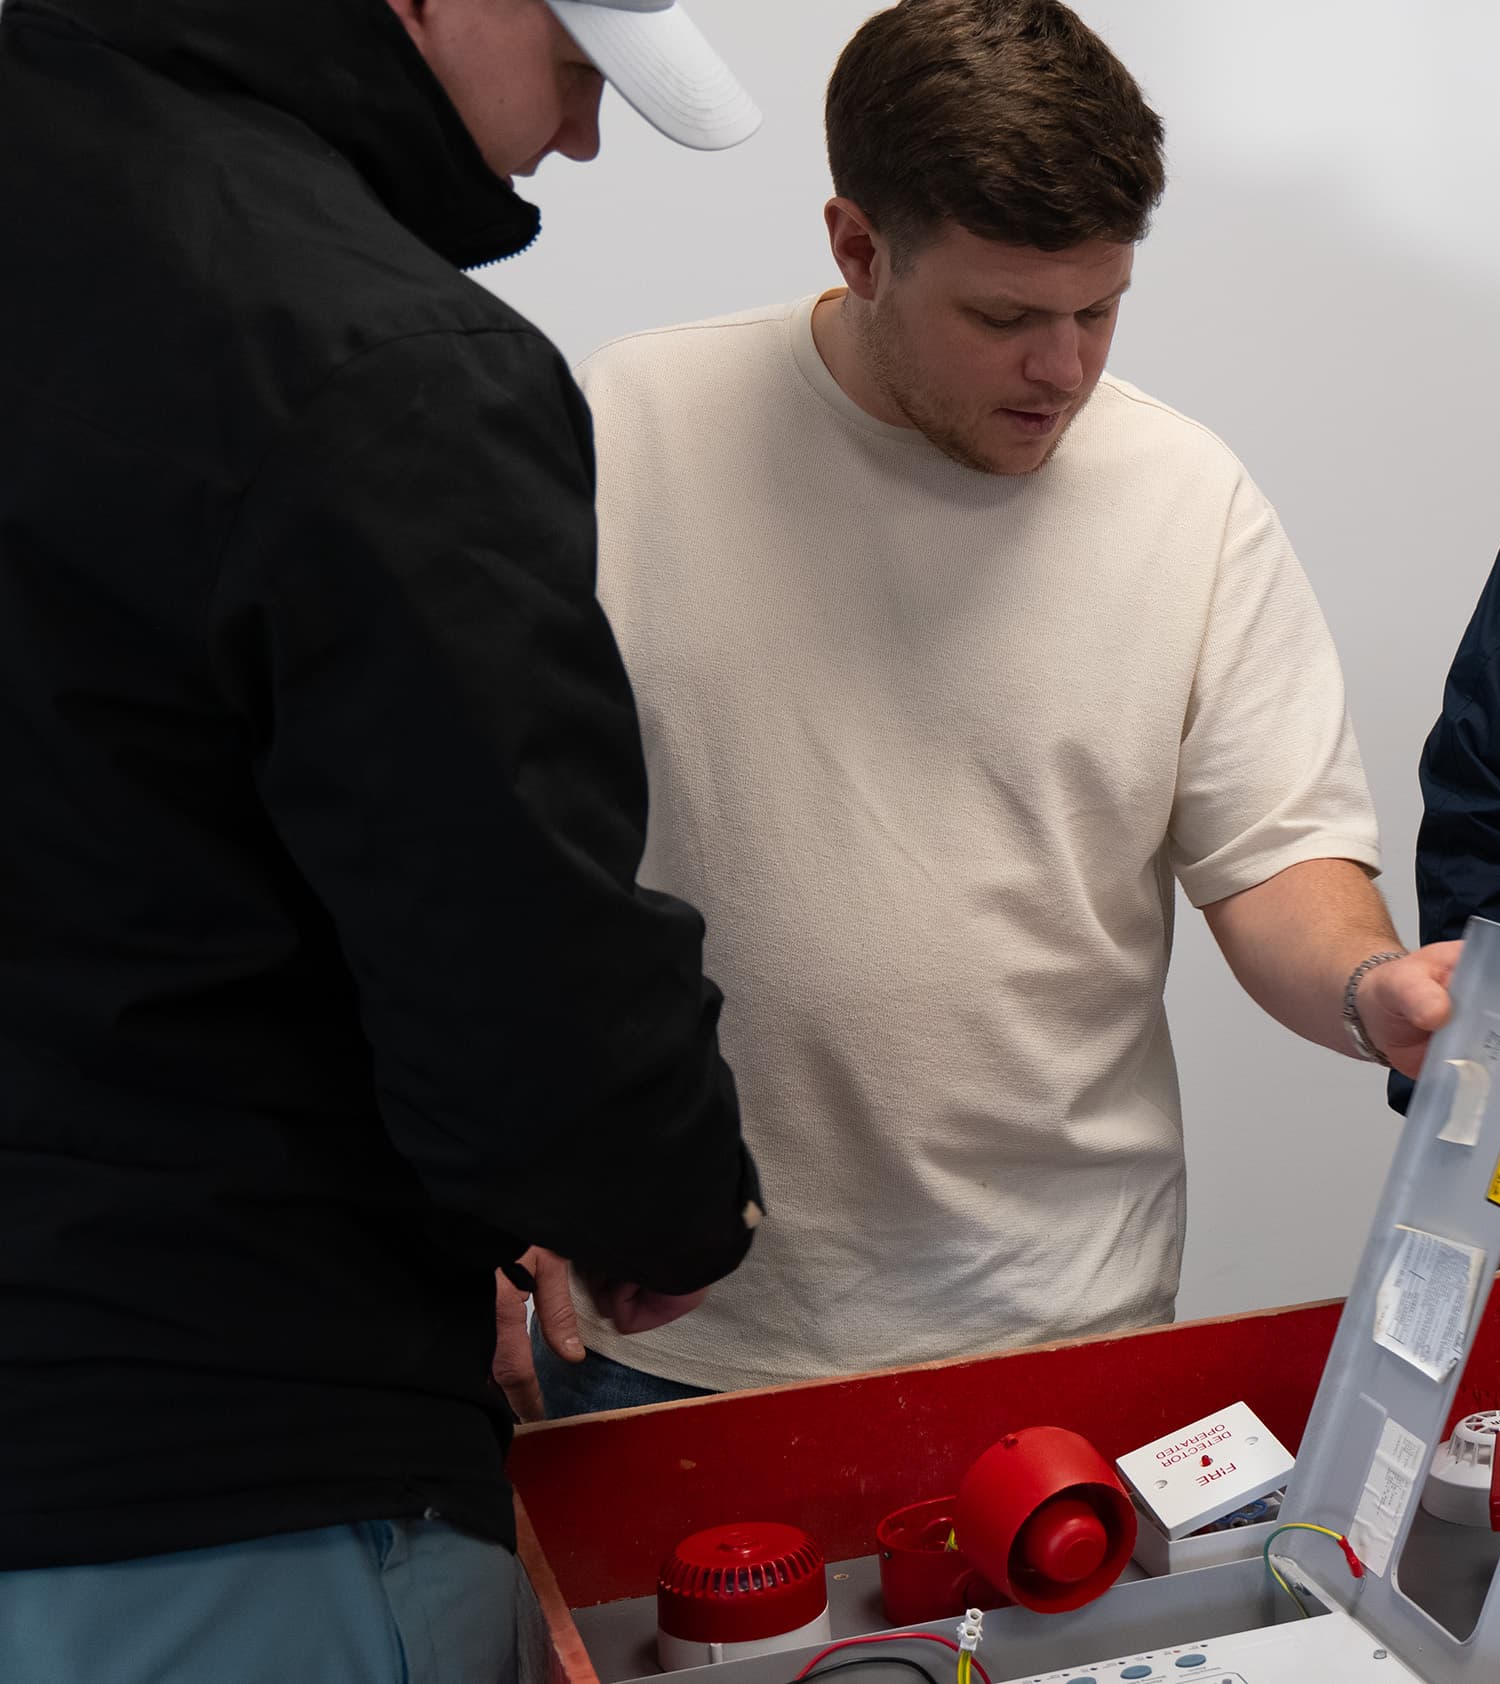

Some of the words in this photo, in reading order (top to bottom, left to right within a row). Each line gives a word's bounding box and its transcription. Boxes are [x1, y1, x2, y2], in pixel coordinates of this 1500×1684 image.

[1156, 1424, 1226, 1460] OPERATED
[1161, 1431, 1232, 1467] DETECTOR
[1195, 1462, 1237, 1487] FIRE
